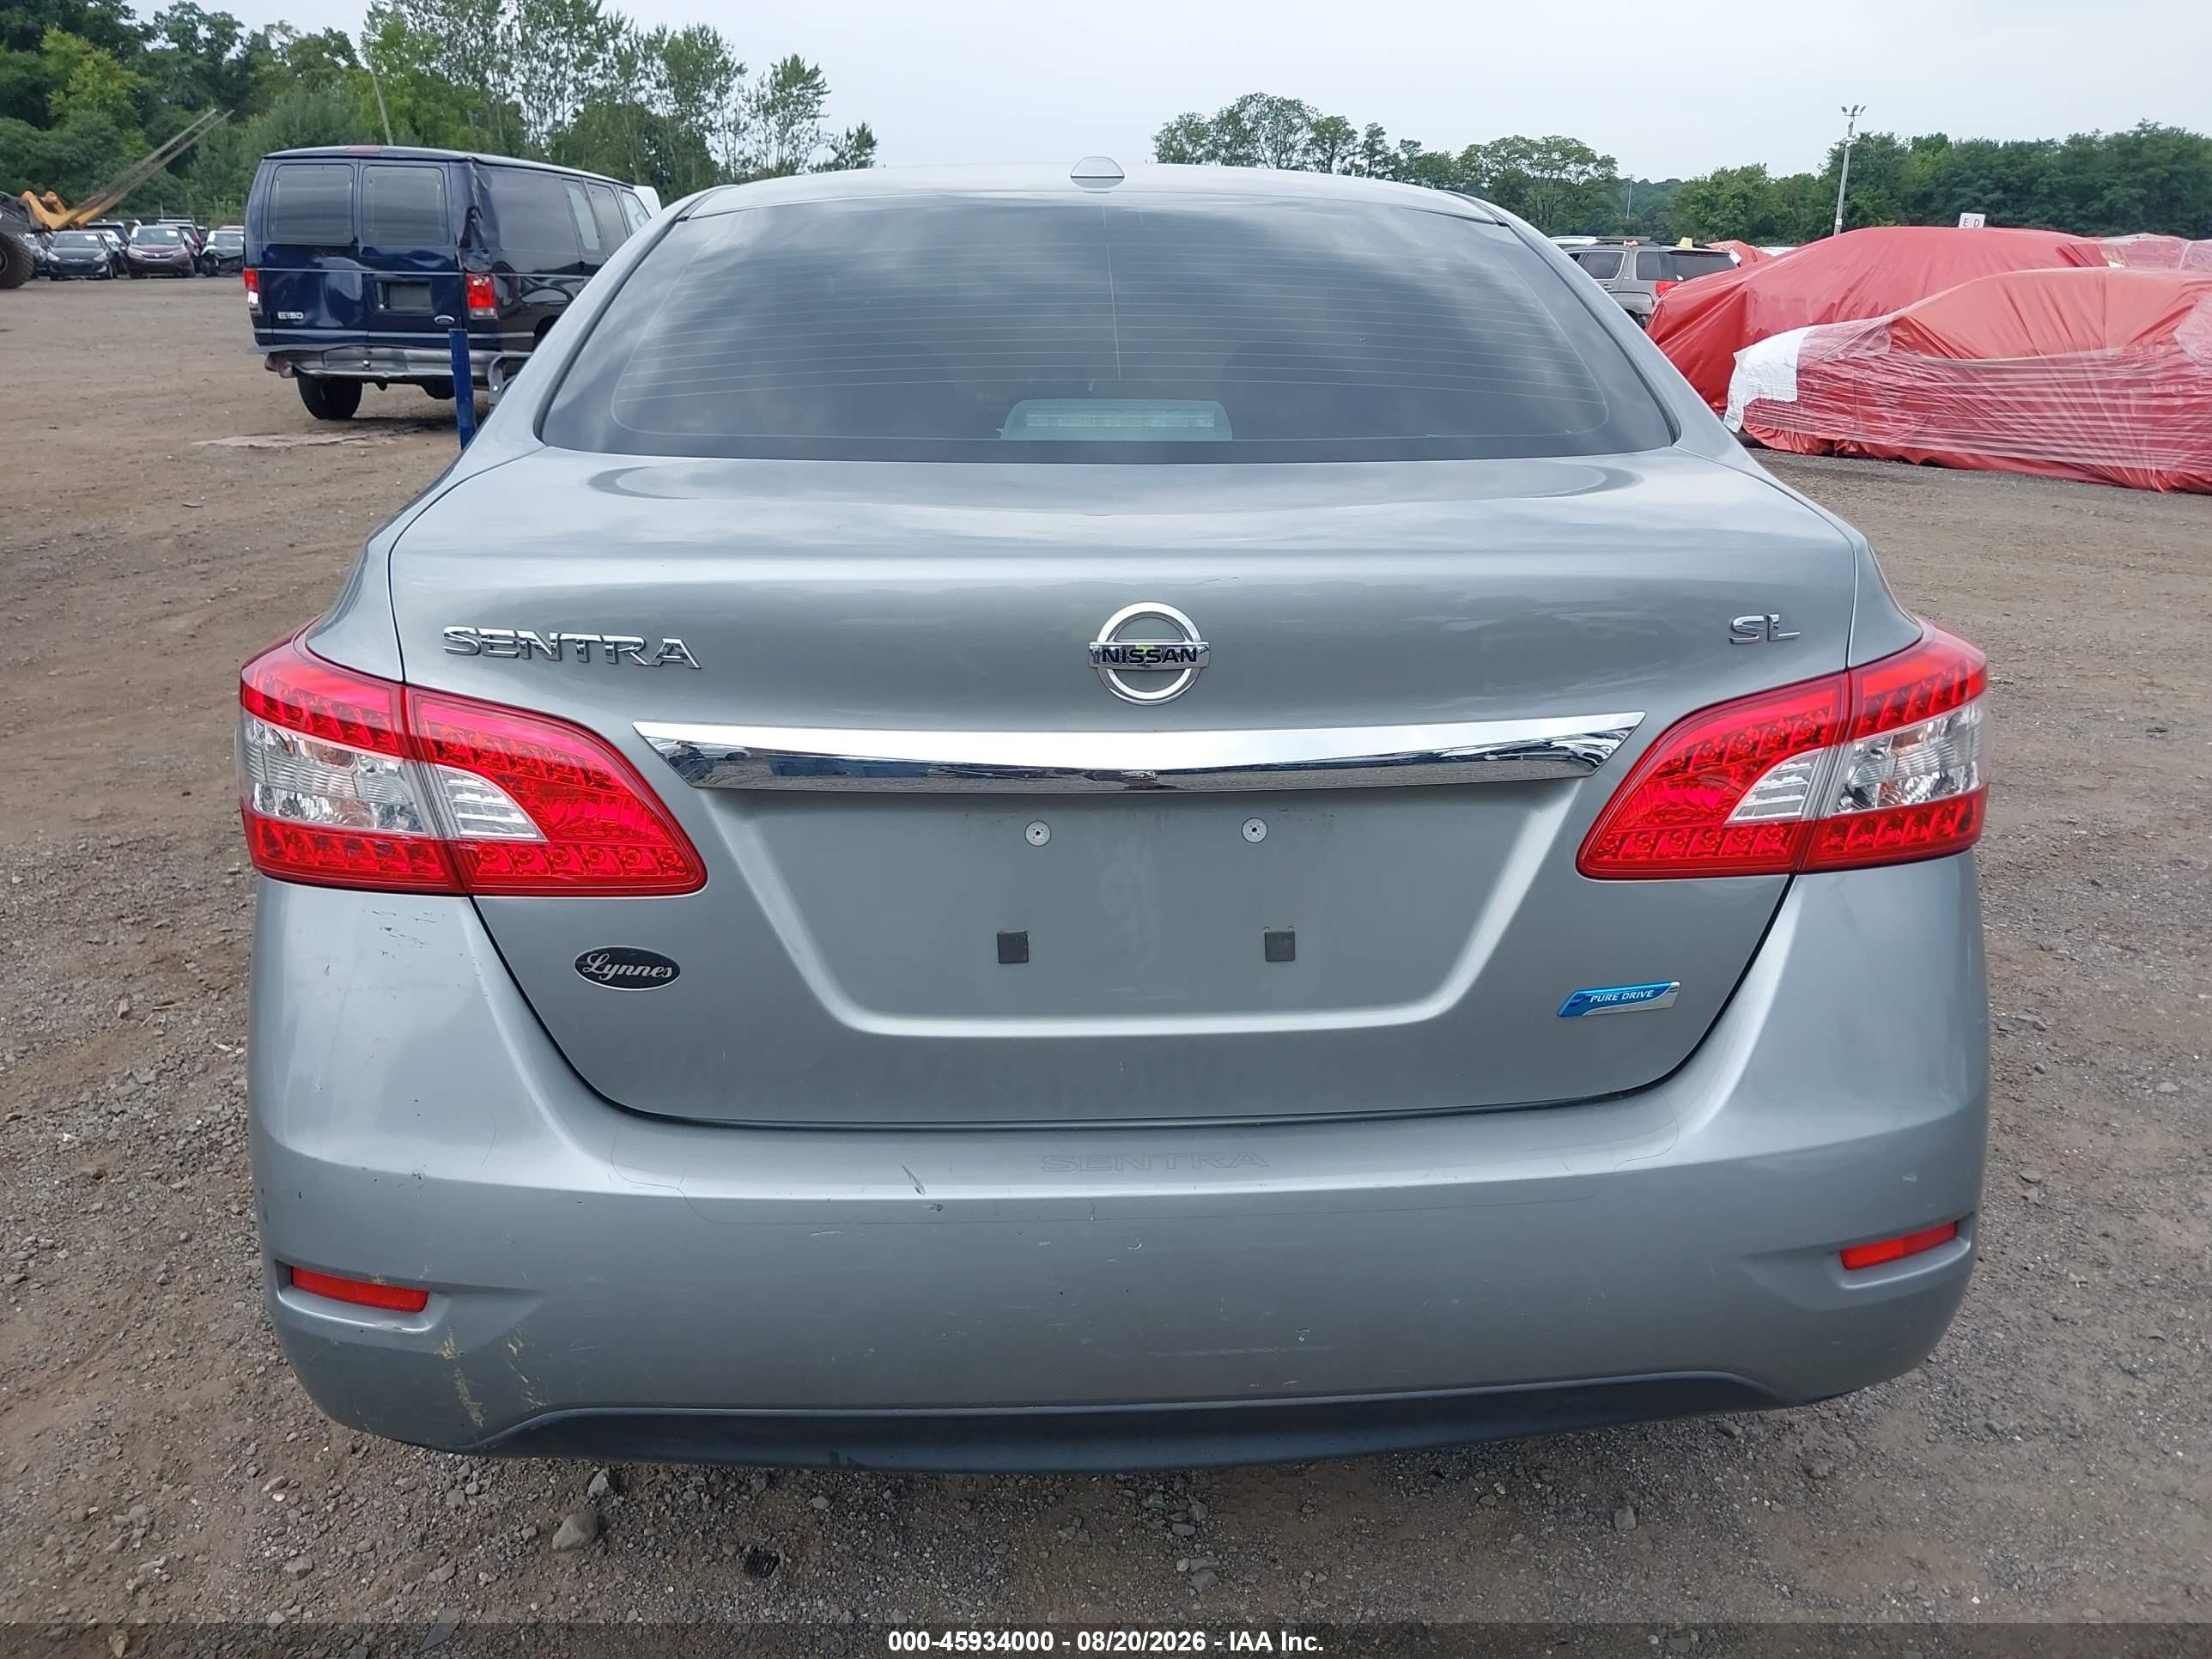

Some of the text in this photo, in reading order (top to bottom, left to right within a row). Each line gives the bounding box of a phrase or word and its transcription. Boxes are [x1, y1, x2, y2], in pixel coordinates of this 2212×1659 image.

[1729, 613, 1800, 644] SL
[442, 625, 702, 669] SENTRA
[1102, 647, 1198, 664] NISSAN
[582, 953, 672, 981] Lynnes
[1589, 989, 1655, 1003] PURE DRIVE
[1041, 1151, 1270, 1172] SENTRA
